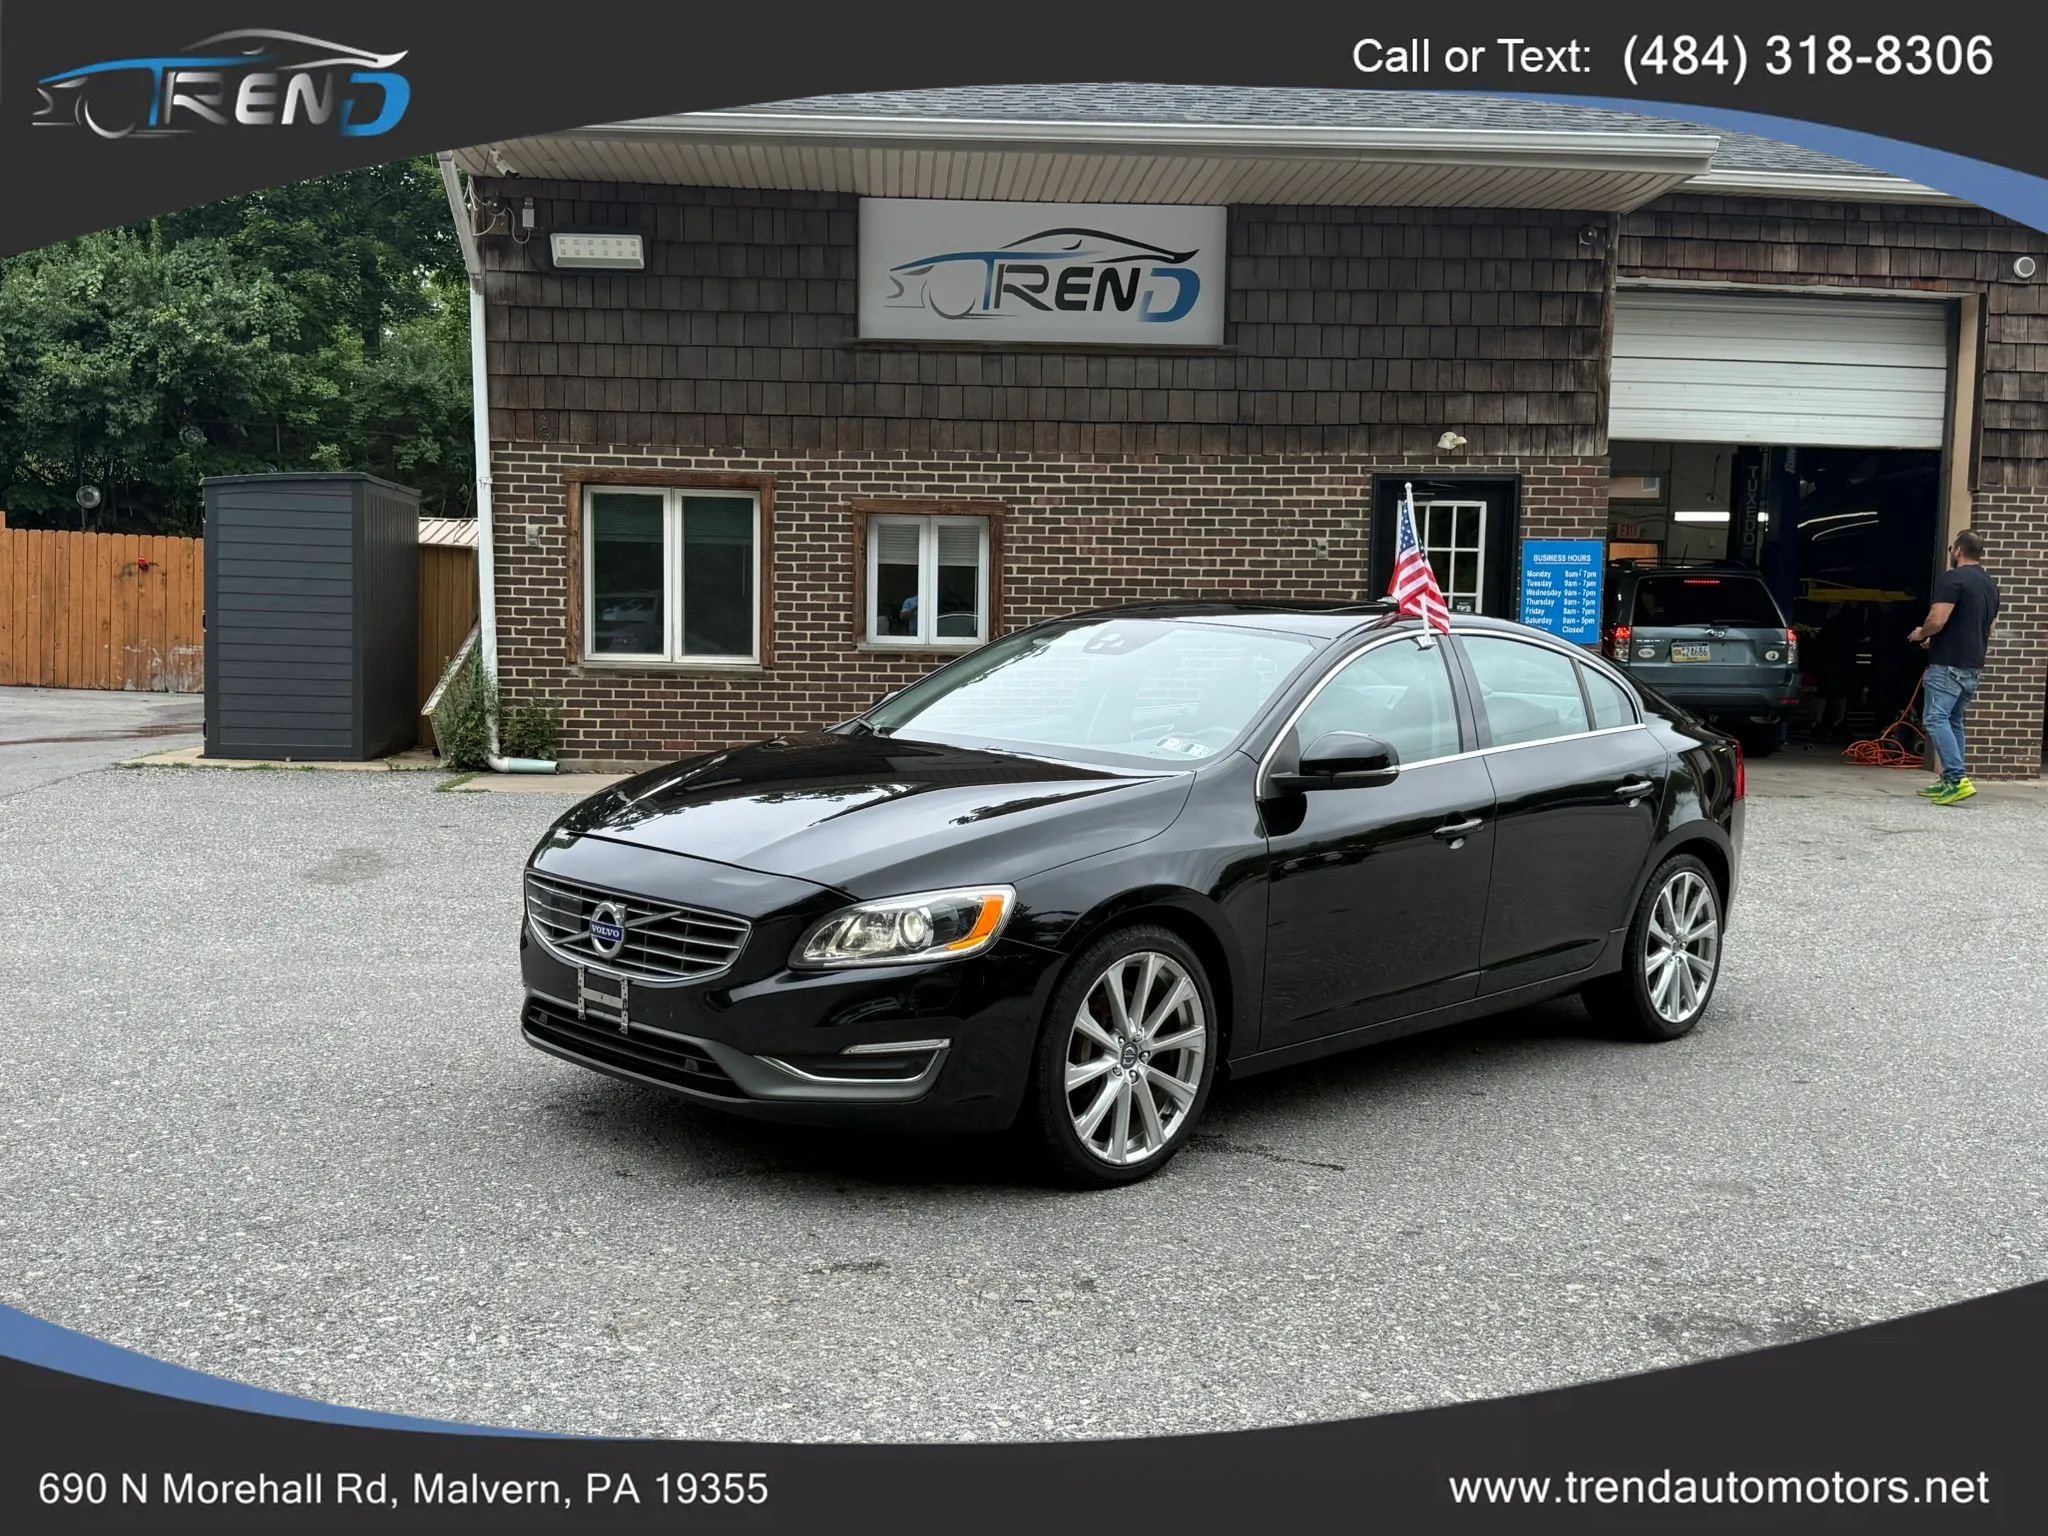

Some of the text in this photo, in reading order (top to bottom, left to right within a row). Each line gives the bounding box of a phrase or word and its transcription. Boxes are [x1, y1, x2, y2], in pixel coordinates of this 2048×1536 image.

[970, 250, 1200, 323] TREND
[1533, 554, 1591, 562] BUSINESS HOURS
[1526, 570, 1551, 578] Monday
[1527, 580, 1552, 588] Tuesday
[1526, 589, 1561, 598] Wednesday
[1526, 598, 1555, 607] Thursday
[1525, 608, 1545, 616] Friday
[1525, 617, 1552, 625] Saturday
[592, 925, 620, 938] VOLVO
